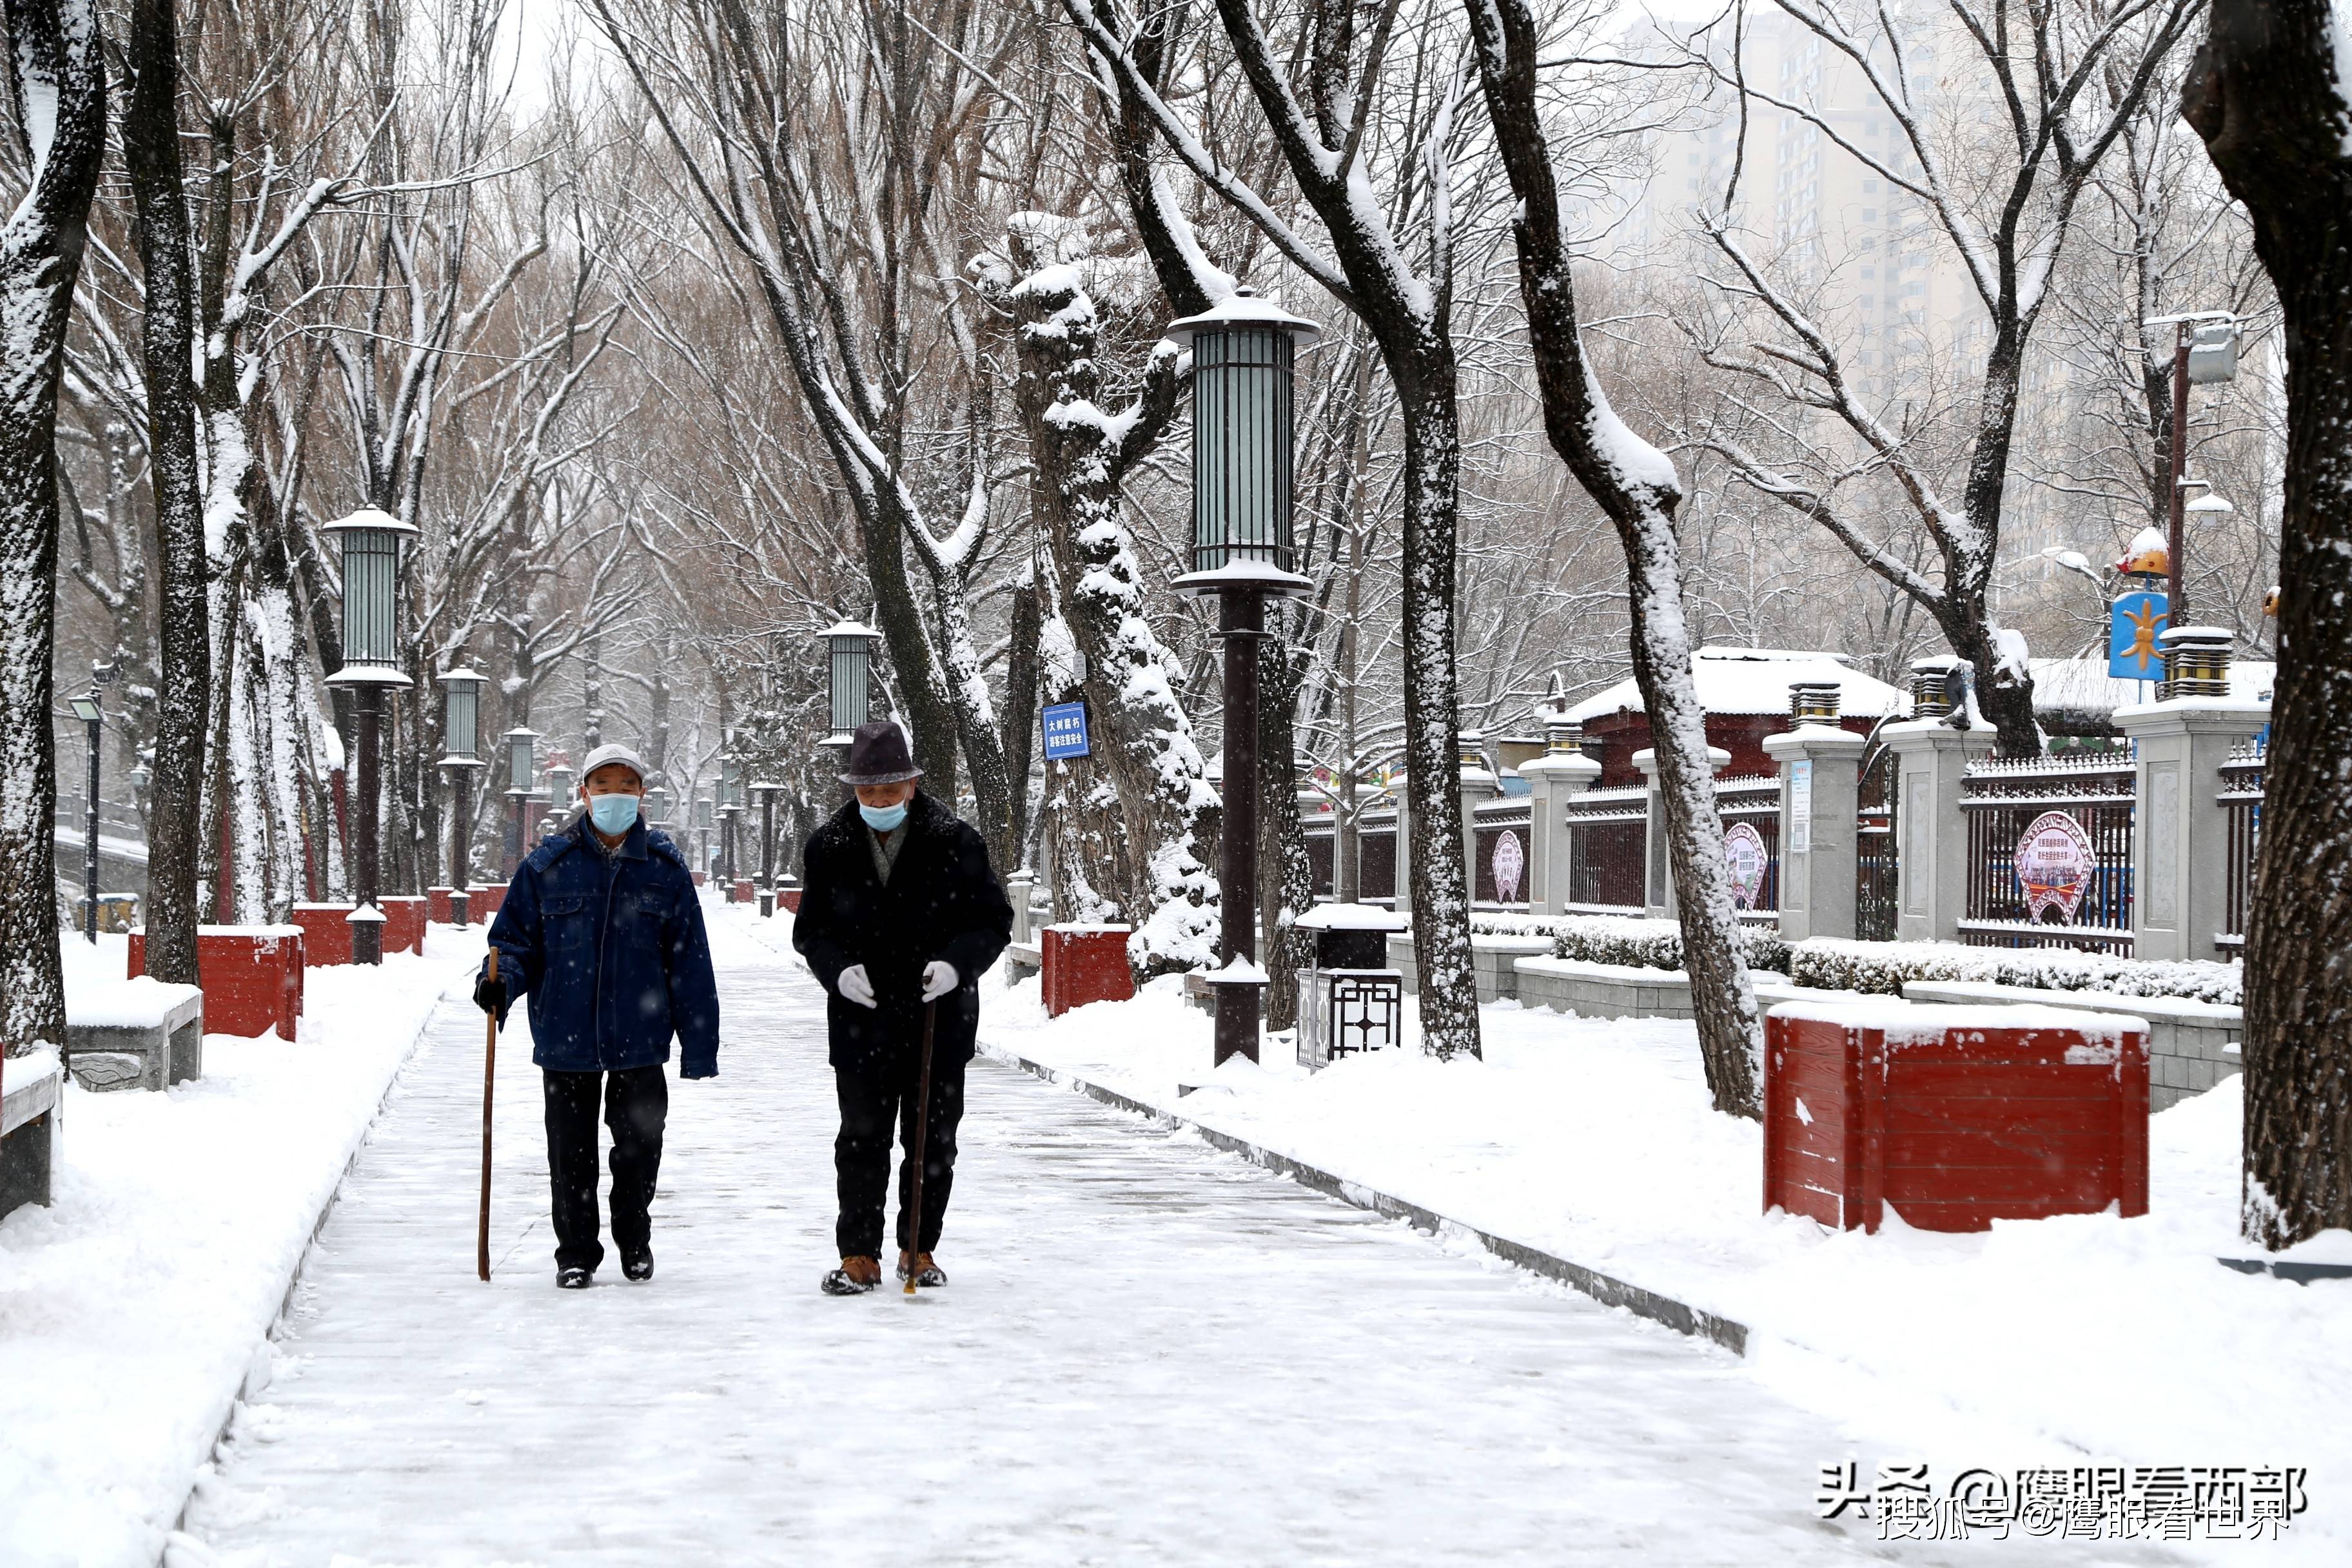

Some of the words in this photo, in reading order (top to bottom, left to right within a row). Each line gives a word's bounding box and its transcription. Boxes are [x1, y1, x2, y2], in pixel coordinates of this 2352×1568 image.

[1049, 717, 1080, 732] 大树腐朽
[1049, 732, 1082, 747] 游客注意安全
